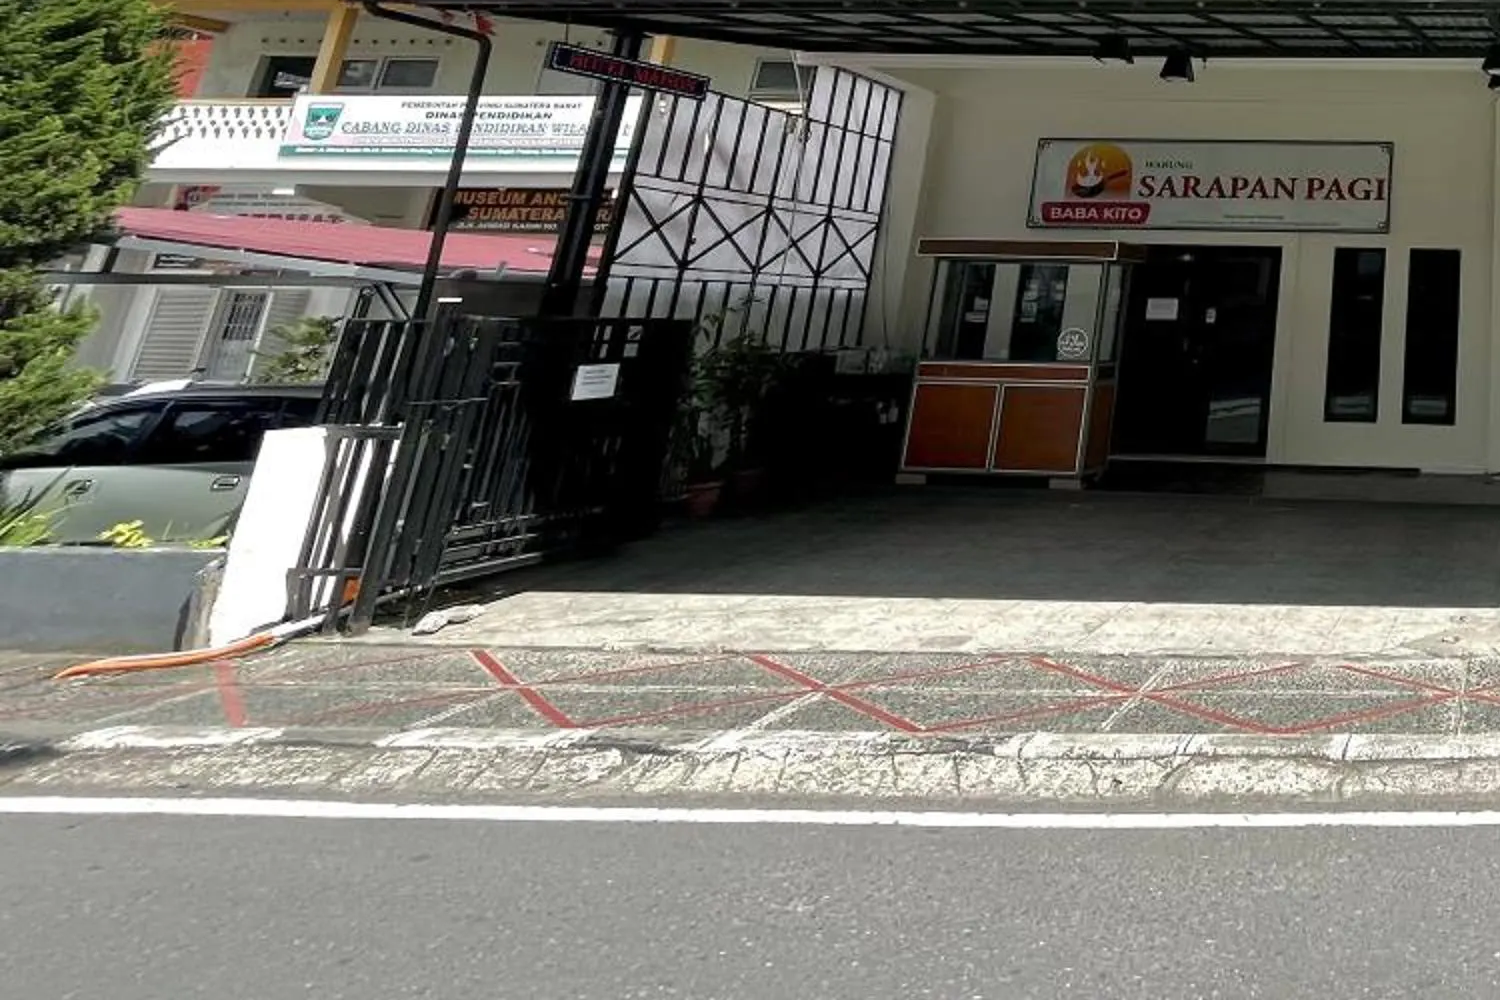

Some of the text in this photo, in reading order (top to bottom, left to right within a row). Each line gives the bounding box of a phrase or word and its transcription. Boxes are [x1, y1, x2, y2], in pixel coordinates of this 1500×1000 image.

[341, 122, 401, 134] CABANG
[405, 122, 451, 134] DINAS
[1137, 174, 1386, 201] SARAPAN PAGI
[467, 206, 566, 221] SUMATERA
[1051, 207, 1143, 220] BABA KITO
